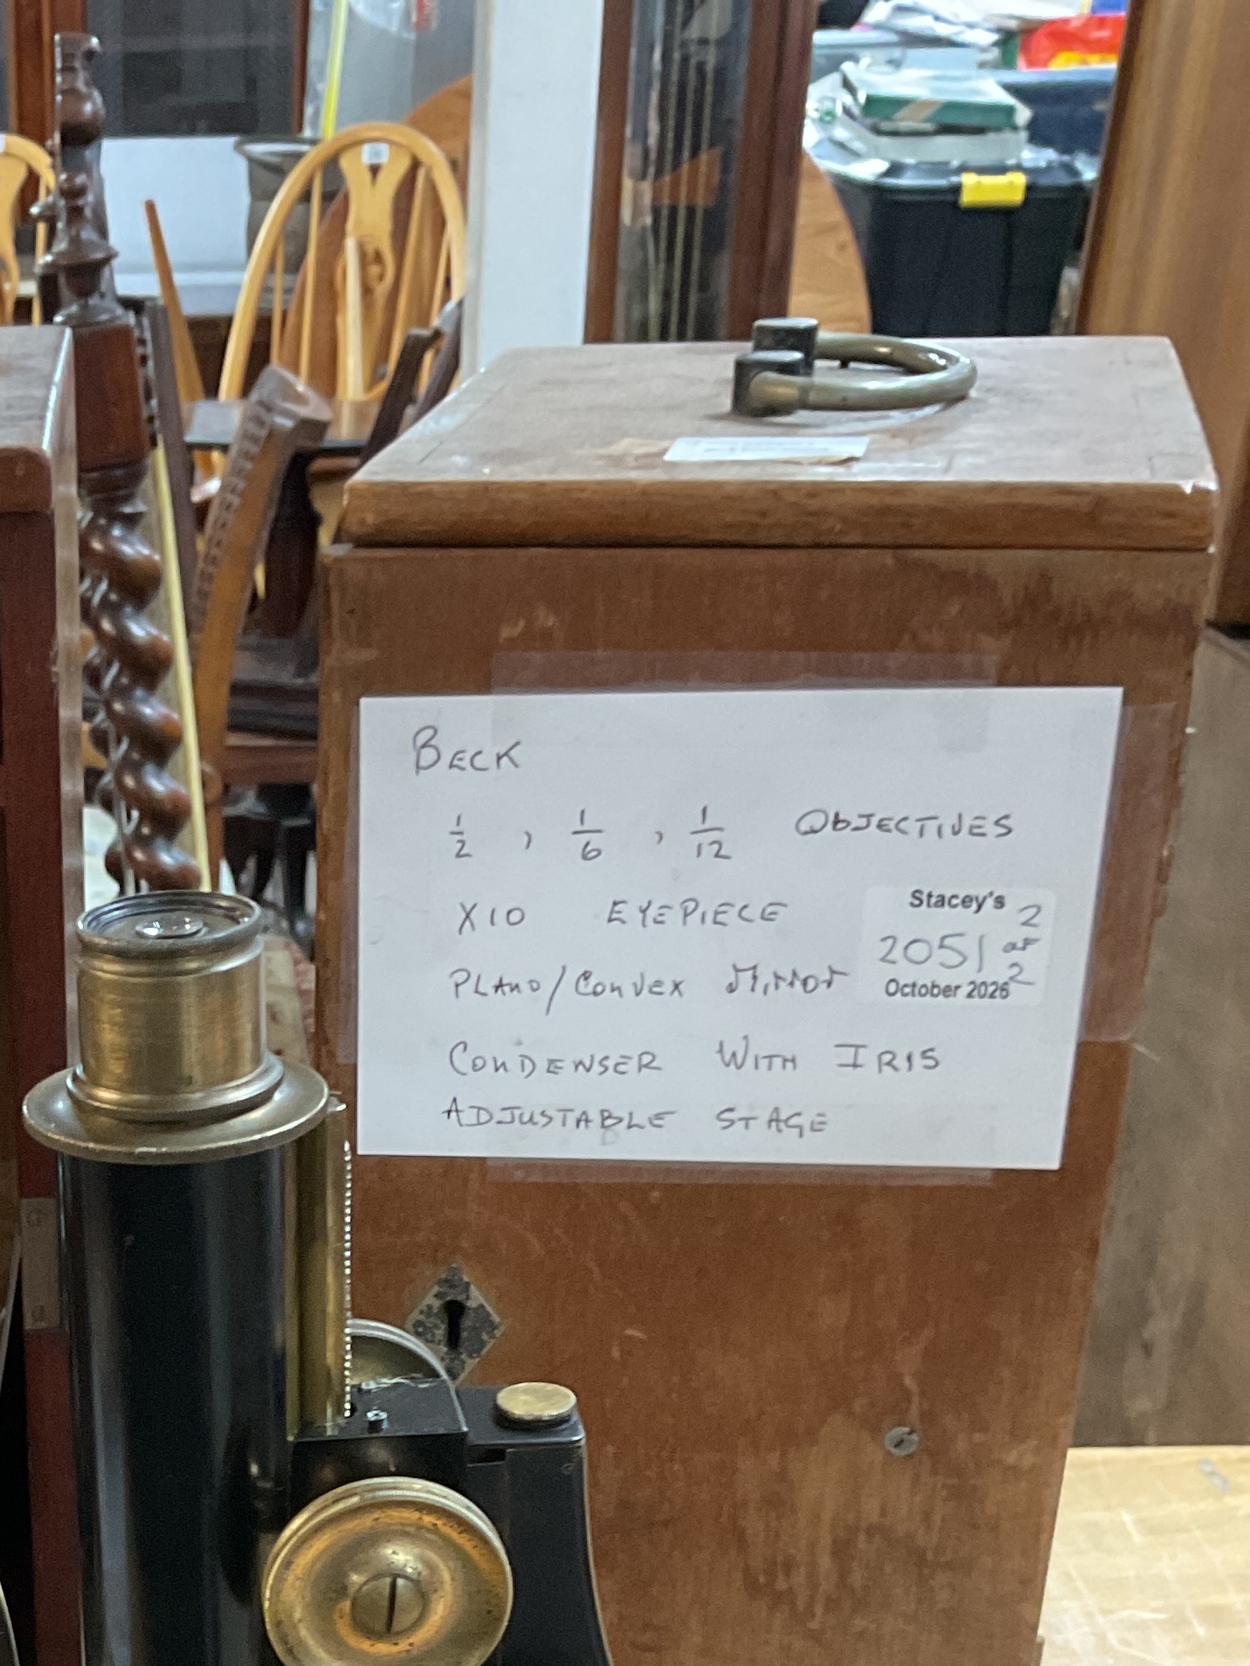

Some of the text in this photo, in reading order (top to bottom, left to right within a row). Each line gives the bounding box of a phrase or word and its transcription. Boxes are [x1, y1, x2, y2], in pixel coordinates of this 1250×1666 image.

[411, 723, 522, 777] BECK
[606, 896, 789, 929] EYEPIECE
[908, 888, 1007, 915] Stacey's
[884, 977, 963, 1000] October
[833, 1042, 941, 1075] IRIS
[440, 1095, 829, 1140] ADJUSTABLE STAGE
